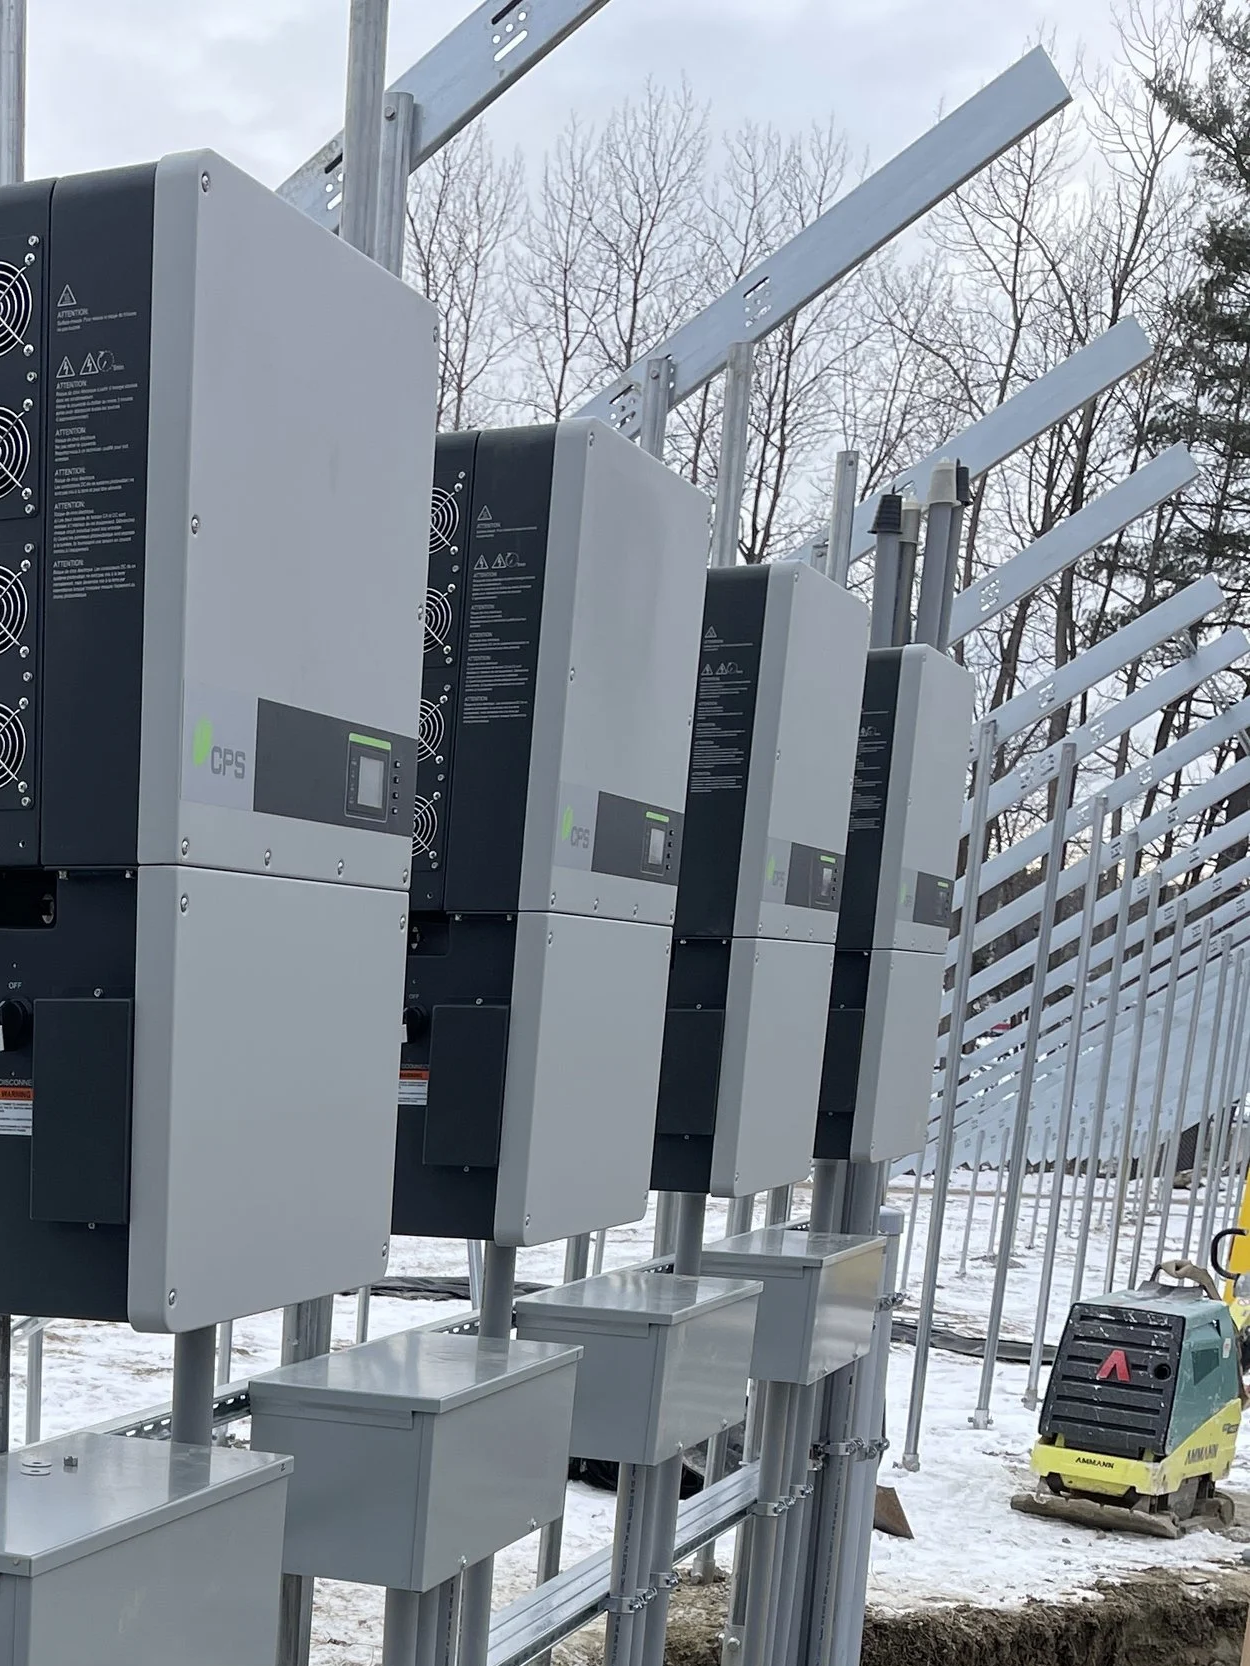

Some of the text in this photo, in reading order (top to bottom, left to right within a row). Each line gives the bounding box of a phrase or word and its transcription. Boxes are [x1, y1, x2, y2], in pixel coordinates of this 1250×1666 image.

[211, 745, 246, 780] CPS
[570, 826, 590, 849] CPS
[8, 981, 22, 990] OFF
[1075, 1456, 1114, 1469] AMMANN
[1184, 1444, 1220, 1466] AMMANN
